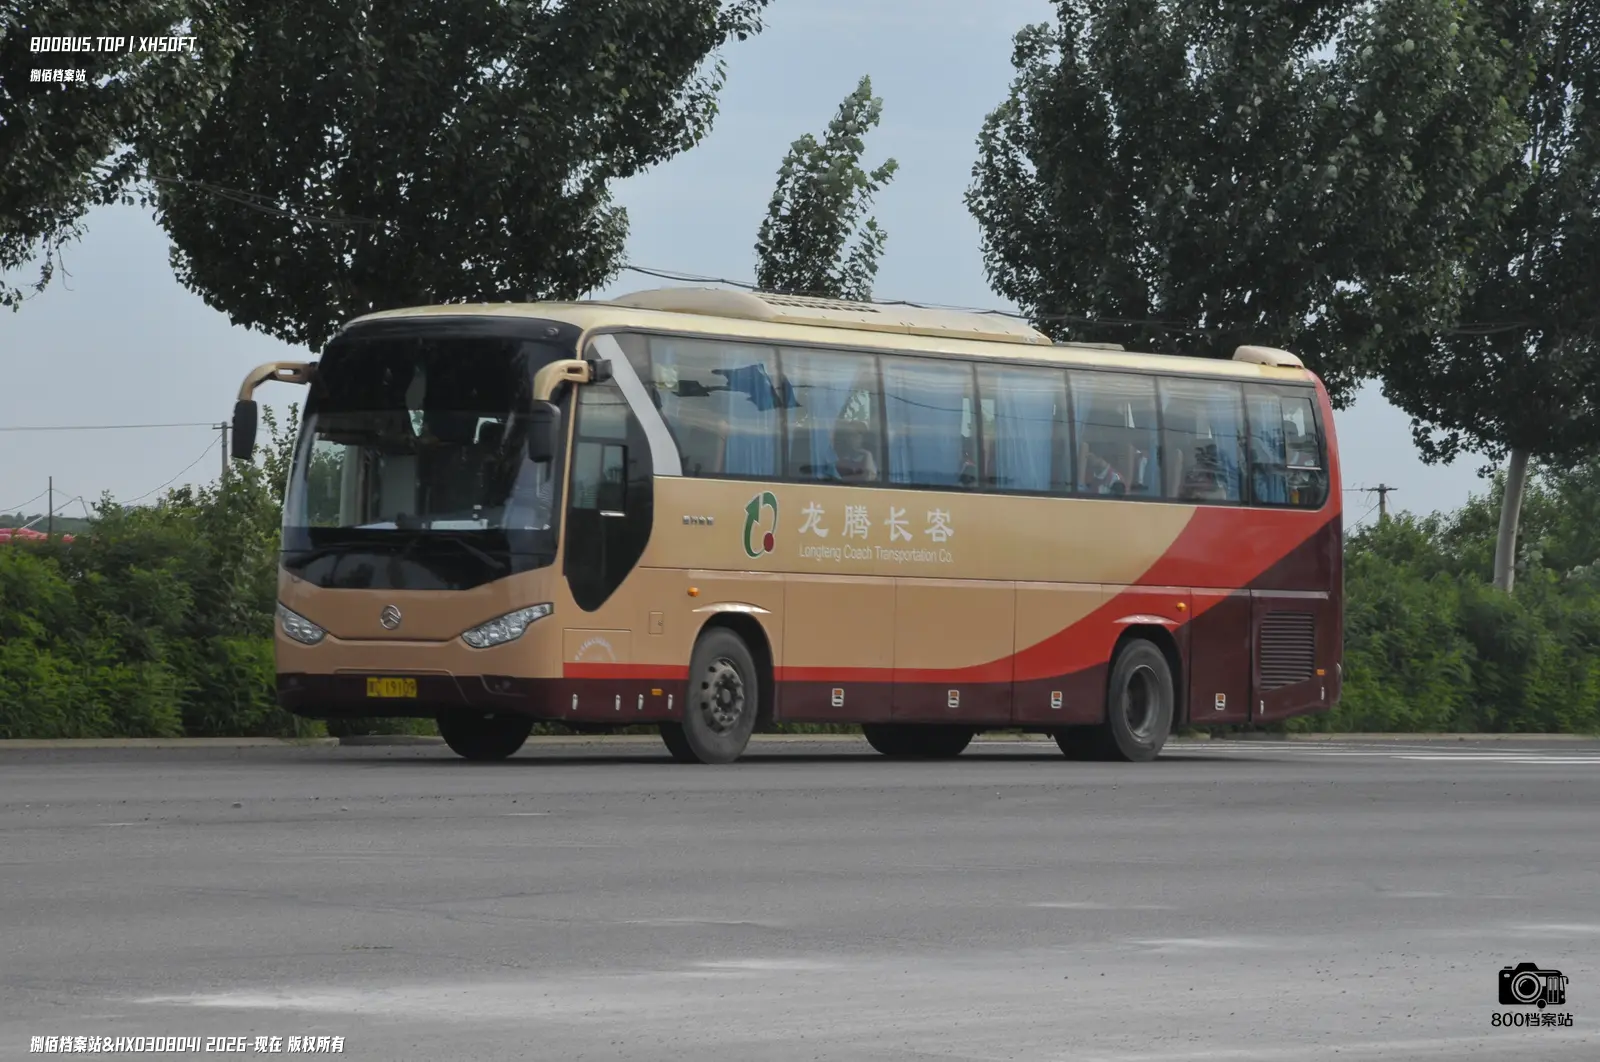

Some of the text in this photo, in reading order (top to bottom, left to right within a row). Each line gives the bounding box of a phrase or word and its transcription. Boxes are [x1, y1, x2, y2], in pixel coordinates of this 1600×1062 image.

[798, 502, 955, 543] 龙腾长客
[799, 544, 954, 564] Longteng Coach Transportation Co.
